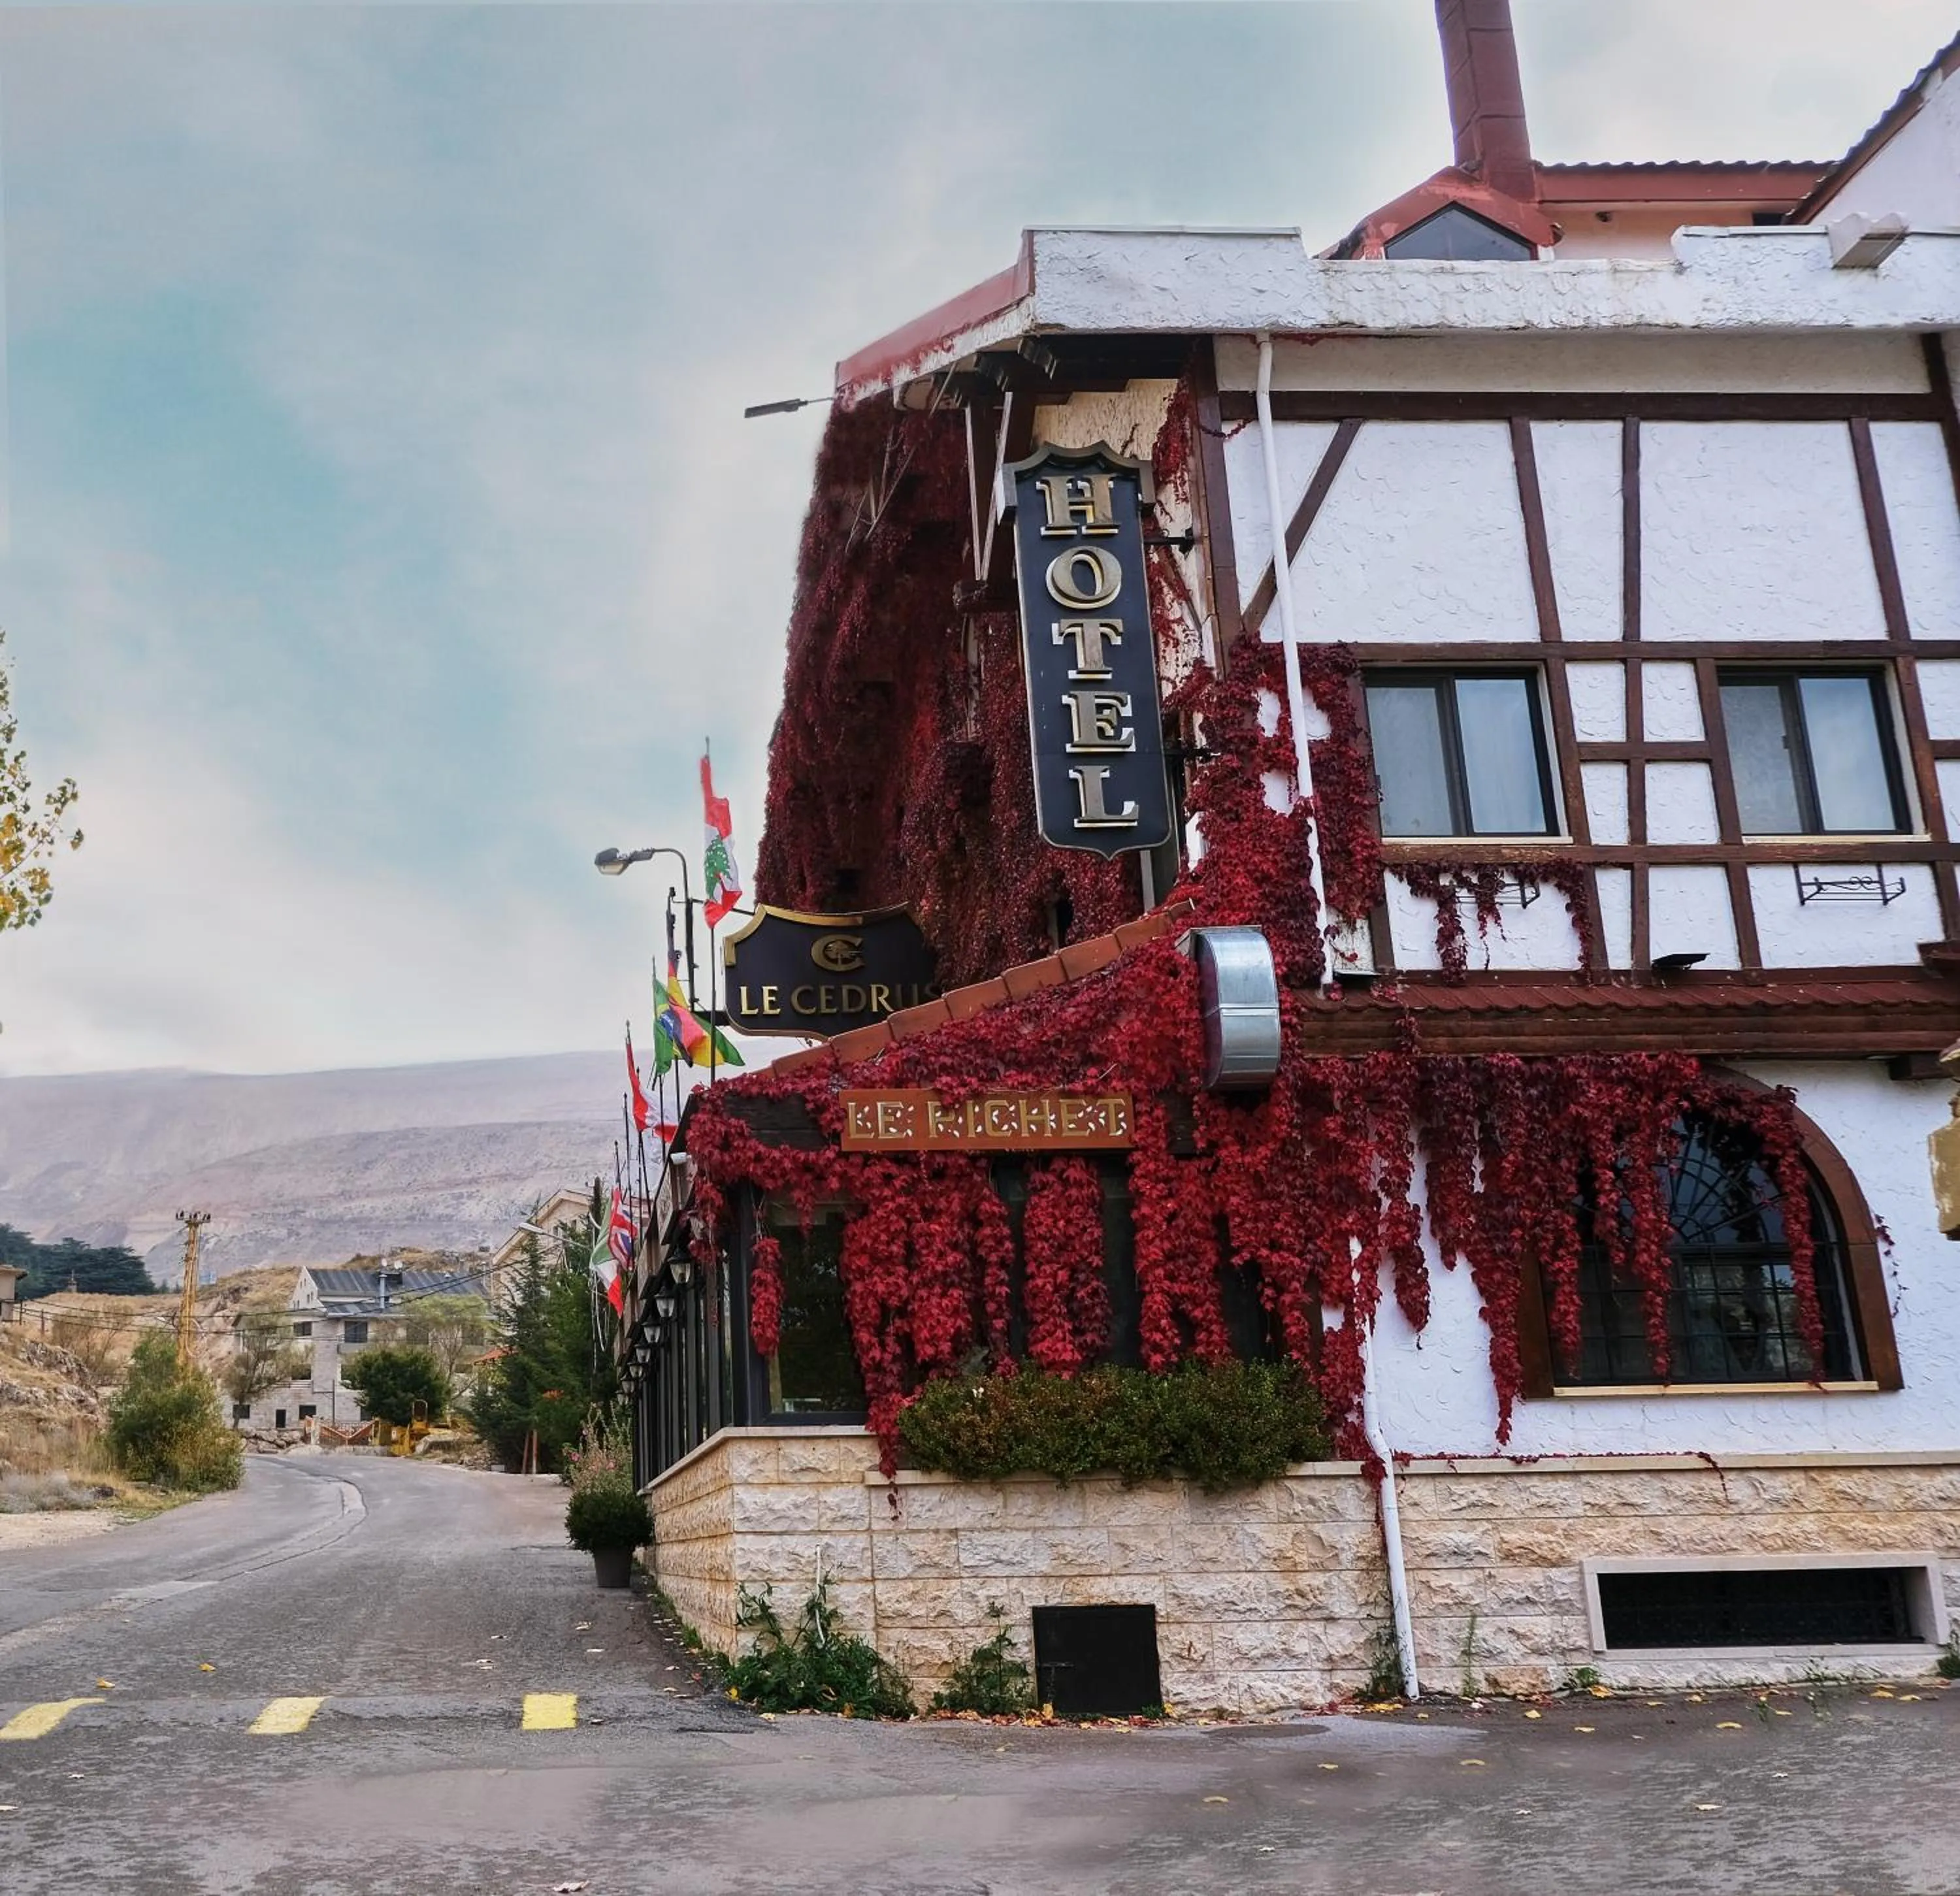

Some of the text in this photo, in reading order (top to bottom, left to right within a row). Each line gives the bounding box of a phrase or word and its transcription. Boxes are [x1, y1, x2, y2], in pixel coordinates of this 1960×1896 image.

[1036, 474, 1139, 828] HOTEL
[740, 985, 781, 1015] LE
[847, 1098, 1126, 1139] LE PICHET
